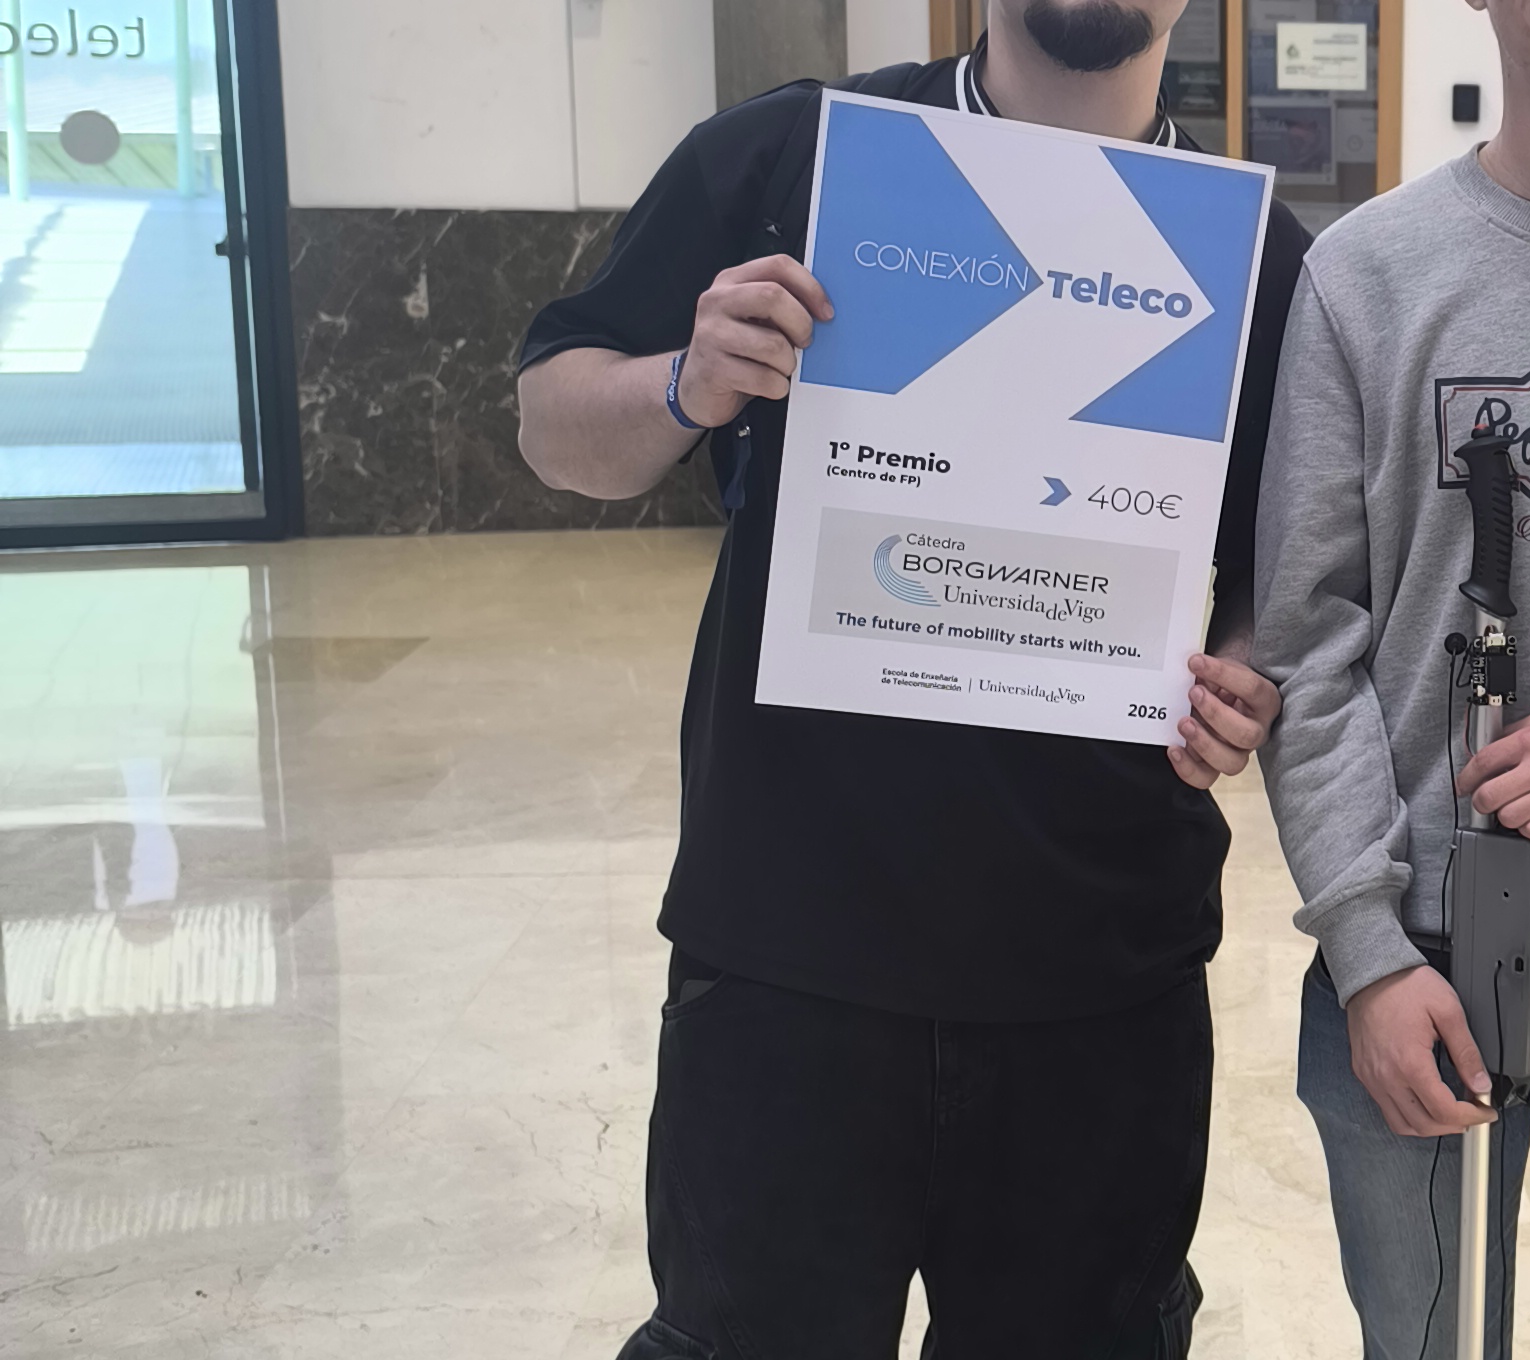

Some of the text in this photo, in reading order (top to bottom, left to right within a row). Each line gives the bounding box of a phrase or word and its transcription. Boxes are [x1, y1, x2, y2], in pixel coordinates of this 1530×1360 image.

[854, 240, 1192, 319] CONEXIÓN Teleco
[857, 444, 951, 474] Premio
[827, 464, 921, 488] (Centro de FP)
[1087, 484, 1184, 520] 400€
[906, 533, 966, 552] Cátedra
[902, 553, 1109, 594] BORGWARNER
[836, 611, 1141, 659] The future of mobility starts with you.
[881, 676, 891, 684] de
[882, 667, 908, 677] Escola
[910, 670, 920, 678] de
[1127, 703, 1167, 720] 2026
